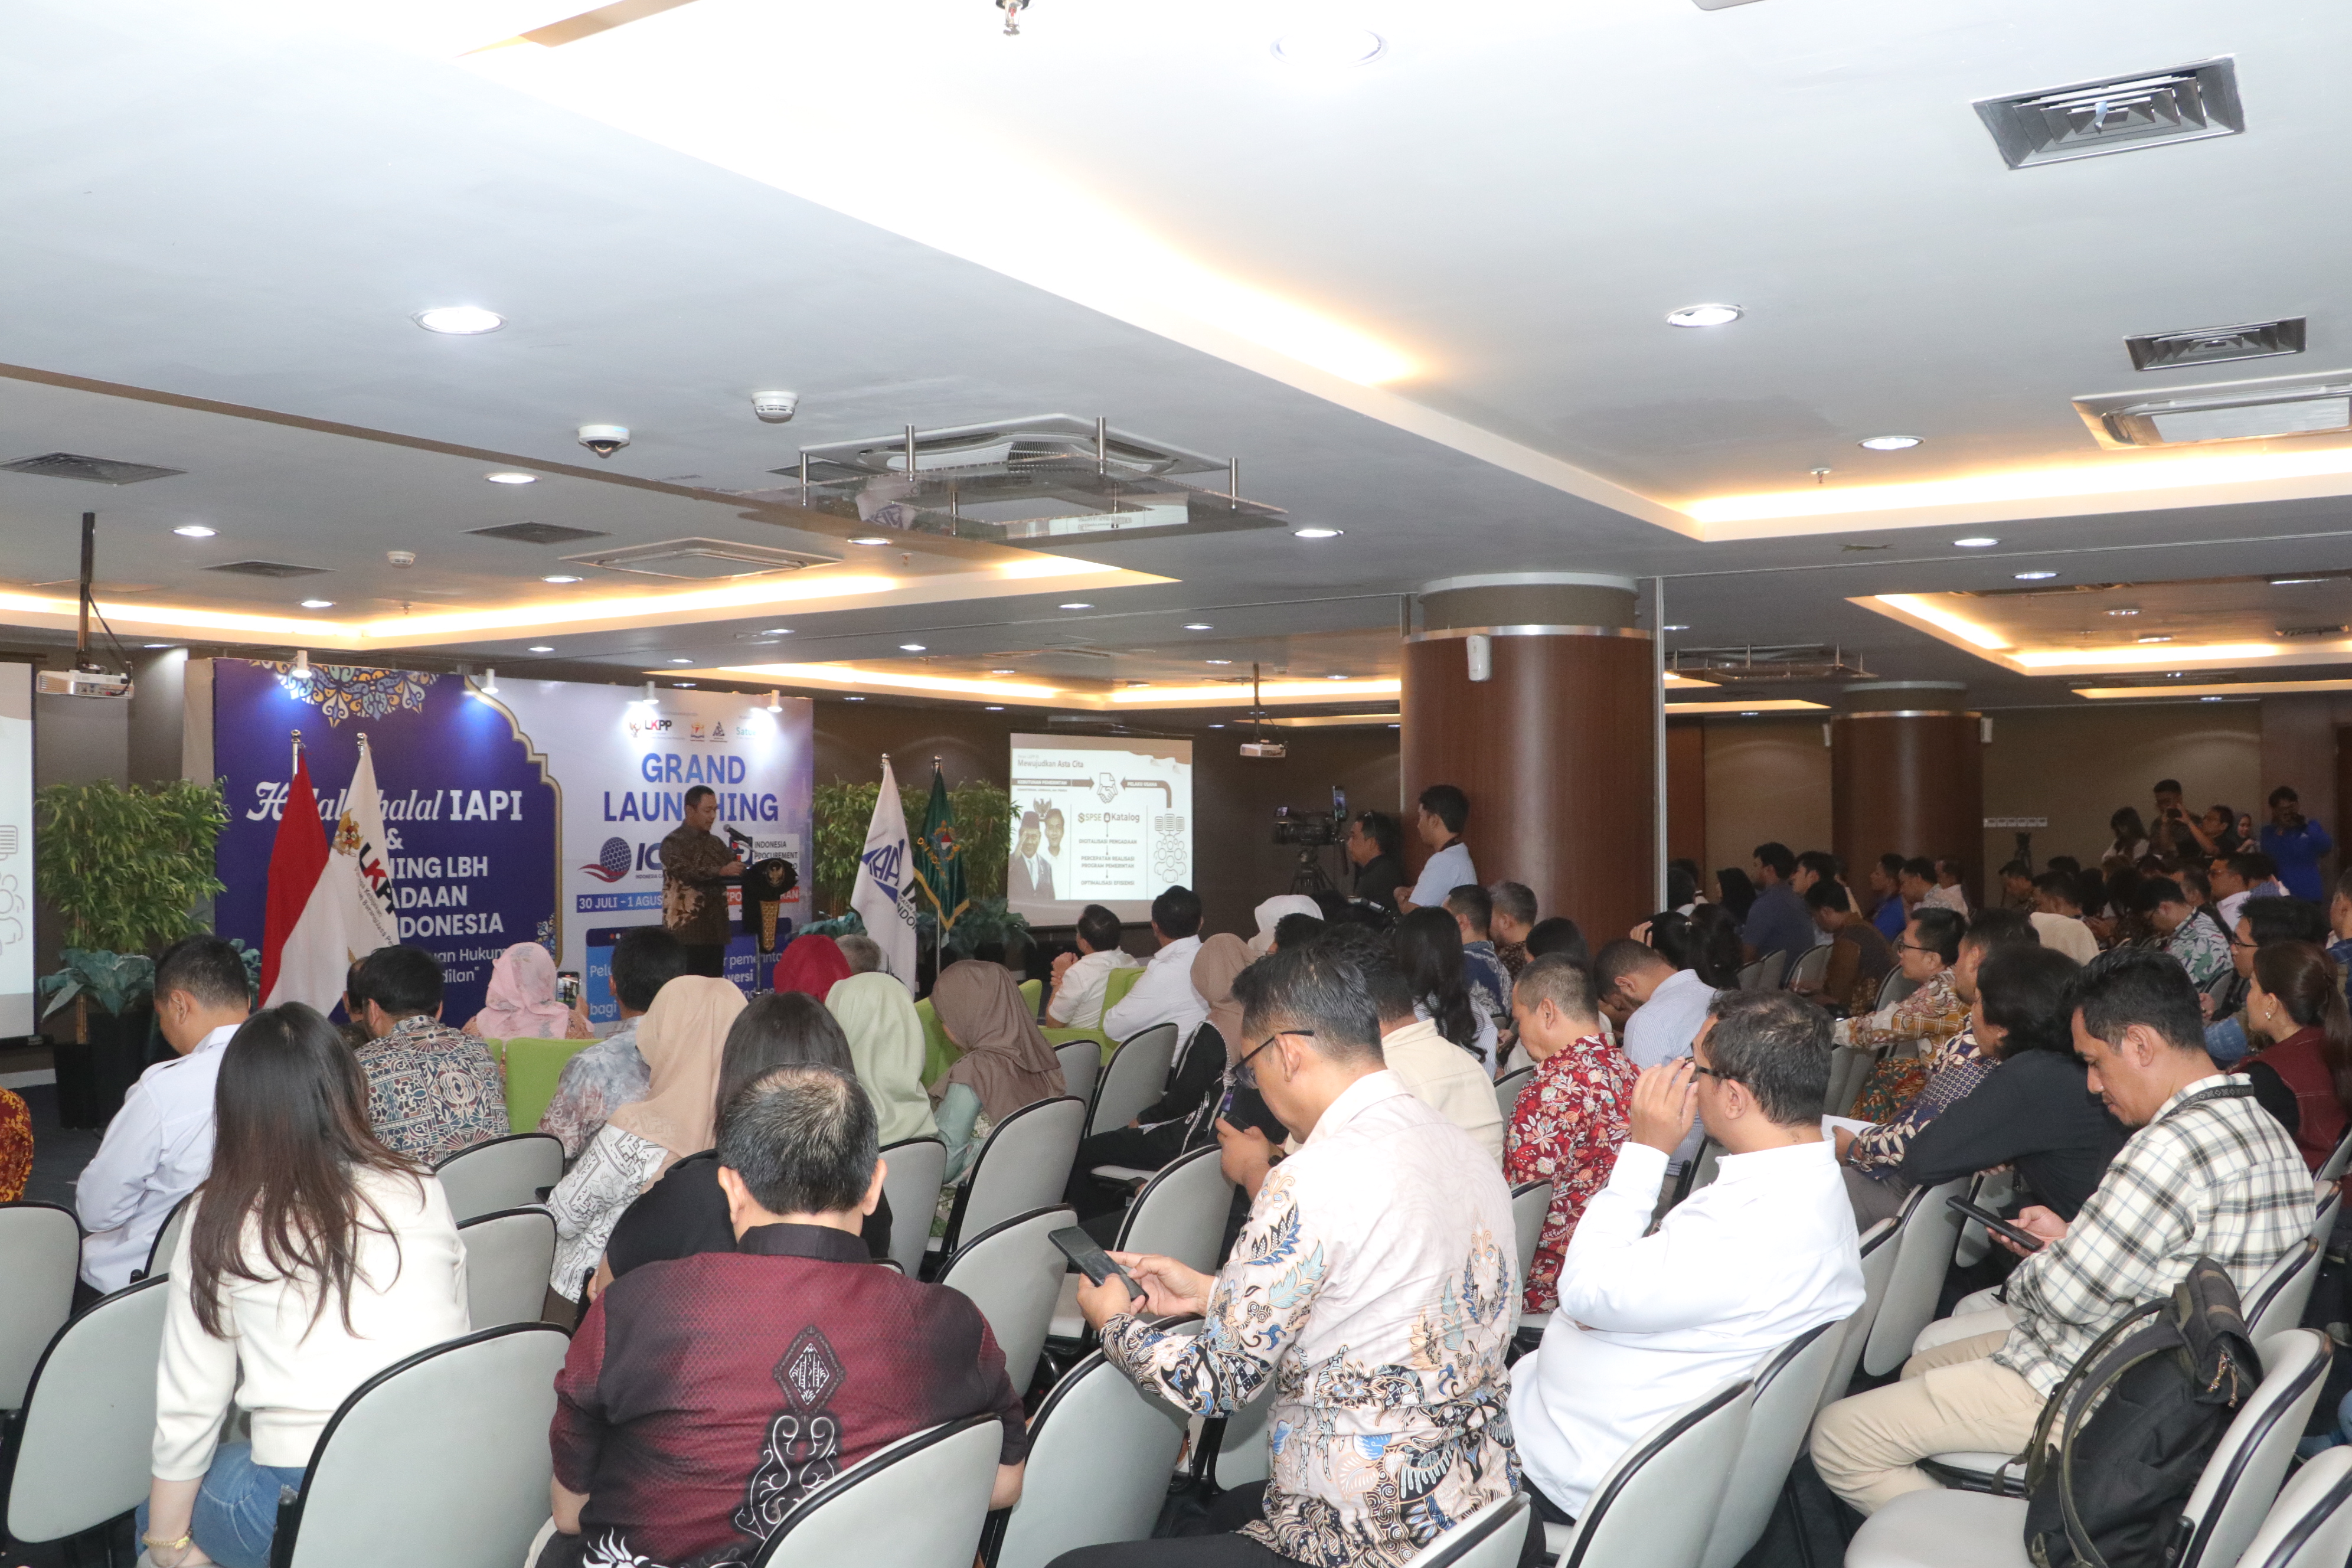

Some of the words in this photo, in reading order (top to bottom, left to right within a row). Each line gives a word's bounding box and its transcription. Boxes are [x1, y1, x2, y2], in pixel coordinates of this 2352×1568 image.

[645, 720, 672, 731] LKPP
[641, 752, 746, 785] GRAND
[1017, 759, 1056, 769] Mewujudkan
[246, 781, 348, 821] Hal
[450, 789, 523, 821] IAPI
[1085, 813, 1102, 821] SPSE
[1111, 812, 1140, 823] Katalog
[386, 828, 404, 850] &
[447, 856, 488, 877] LBH
[579, 897, 593, 910] 30
[594, 897, 618, 909] JULI
[627, 897, 633, 907] 1
[635, 895, 662, 907] AGUS
[399, 912, 505, 938] DONESIA
[590, 963, 613, 978] Pelu
[590, 999, 617, 1018] bagi
